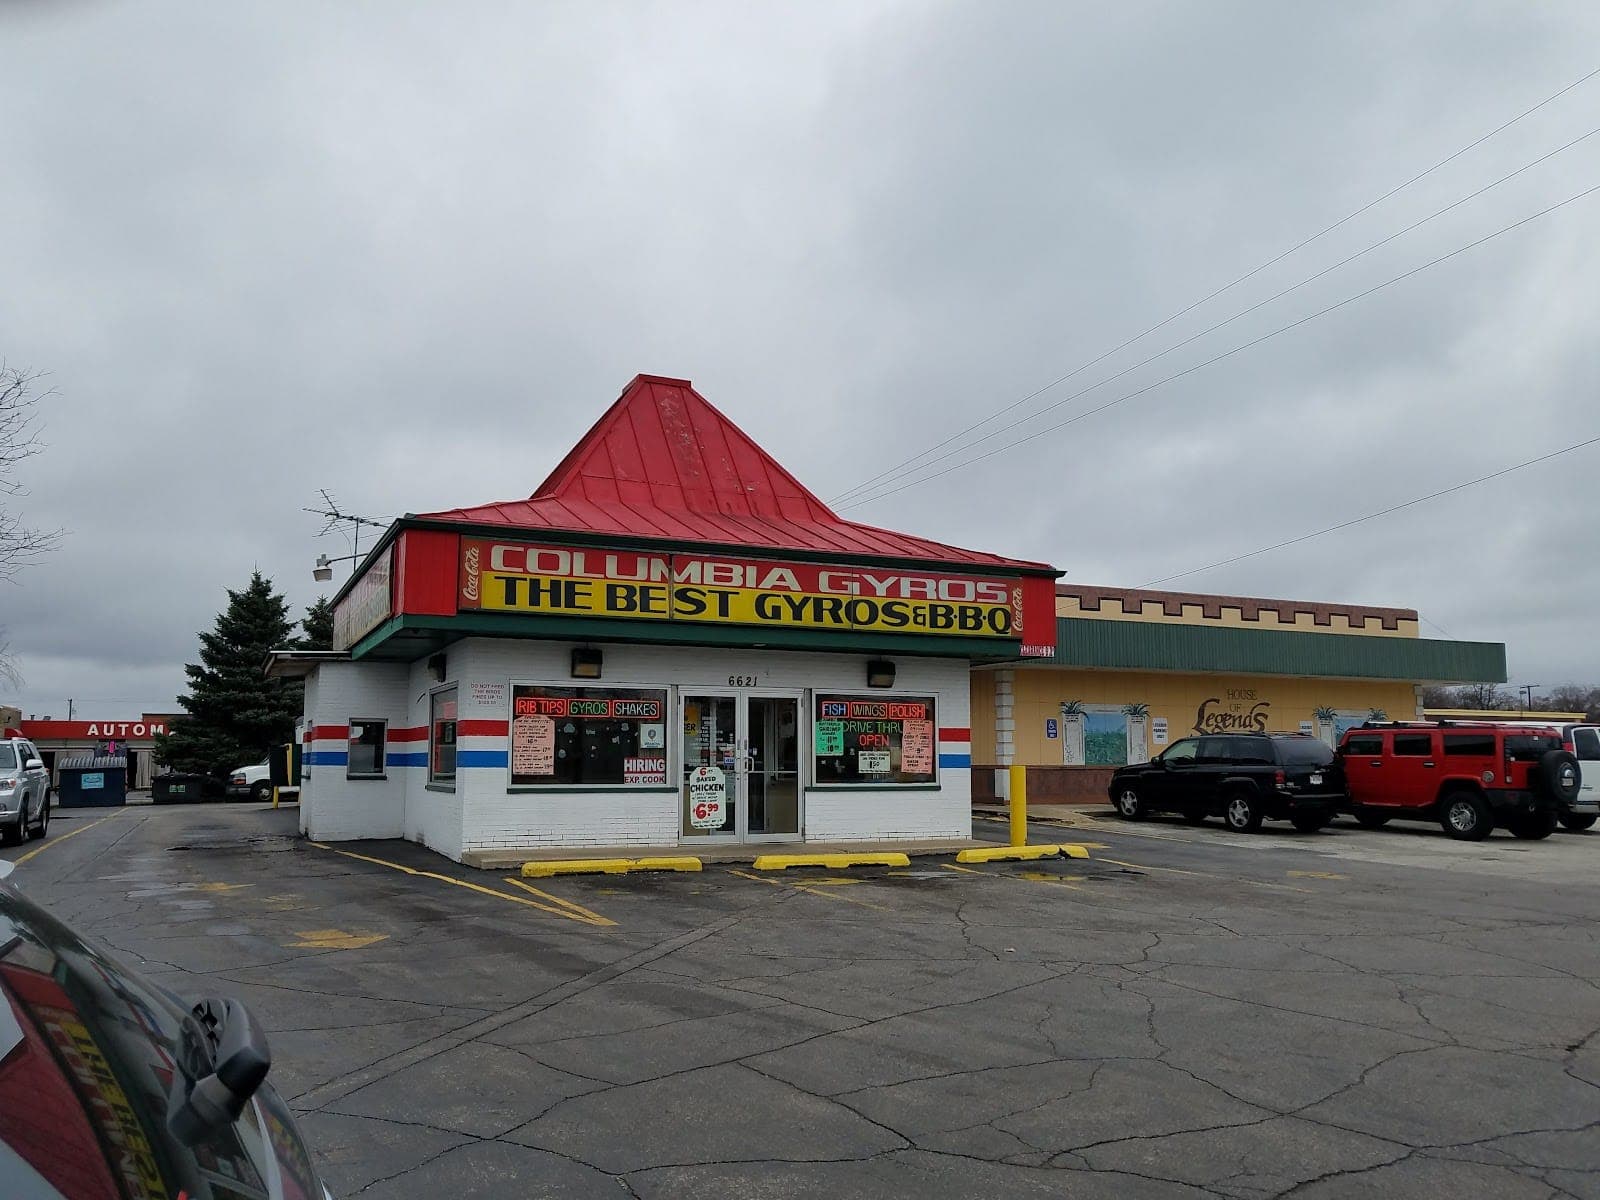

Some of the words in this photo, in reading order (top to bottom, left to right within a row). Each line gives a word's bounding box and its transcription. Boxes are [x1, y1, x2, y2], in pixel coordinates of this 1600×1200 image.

[490, 545, 802, 591] COLUMBIA
[818, 570, 1007, 604] GYROS
[494, 576, 592, 610] THE
[606, 583, 740, 618] BEST
[755, 593, 910, 628] GYROS
[728, 676, 758, 687] 6621
[1227, 688, 1258, 700] HOUSE
[518, 700, 537, 713] RIB
[540, 701, 564, 714] TIPS
[570, 702, 608, 714] GYROS
[615, 702, 657, 716] SHAKES
[823, 703, 847, 716] FISH
[852, 704, 886, 717] WINGS
[891, 705, 924, 718] POLISH
[1229, 703, 1241, 712] OF
[87, 723, 177, 737] AUTOM
[859, 734, 890, 746] OPEN
[624, 758, 665, 773] HIRING
[642, 776, 665, 784] COOK
[690, 783, 725, 793] CHICKEN
